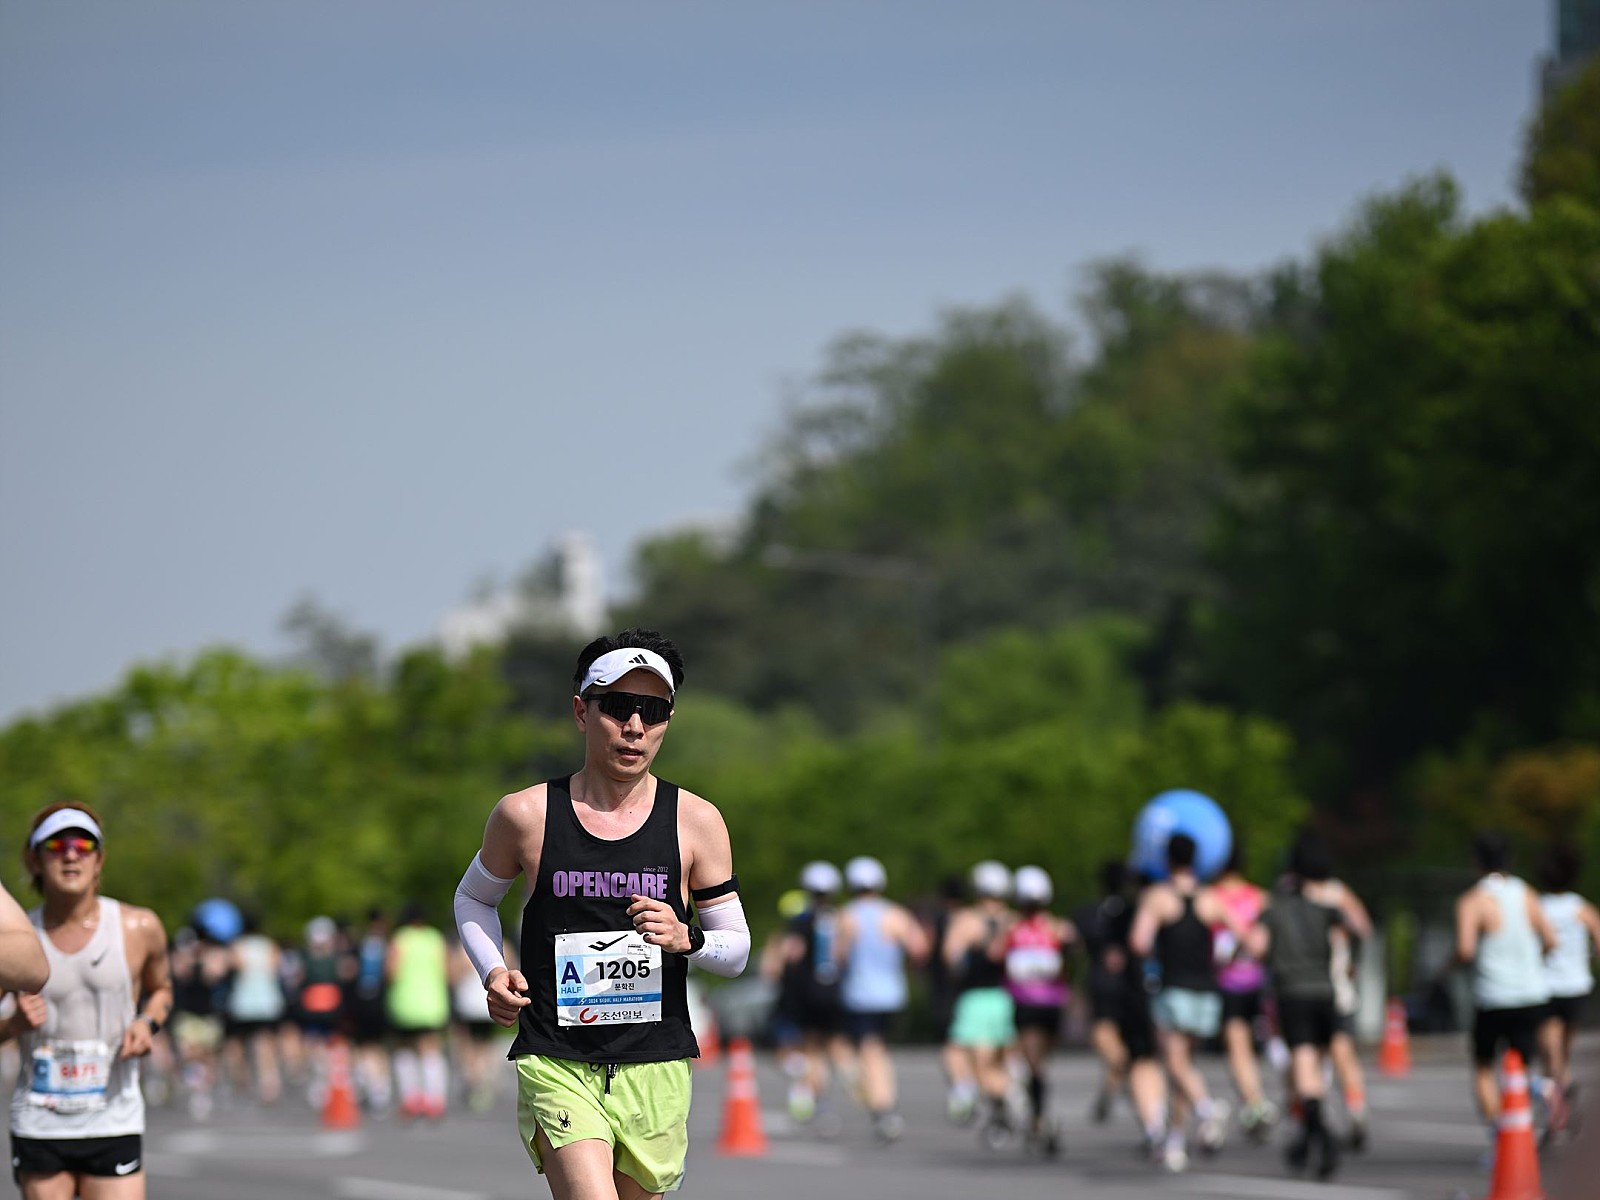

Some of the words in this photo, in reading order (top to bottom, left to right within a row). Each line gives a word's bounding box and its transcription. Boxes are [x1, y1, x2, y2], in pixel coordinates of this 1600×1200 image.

[553, 870, 668, 899] OPENCARE
[561, 961, 581, 985] A
[596, 959, 650, 980] 1205
[560, 986, 582, 994] HALF
[600, 1010, 643, 1021] 조선일보
